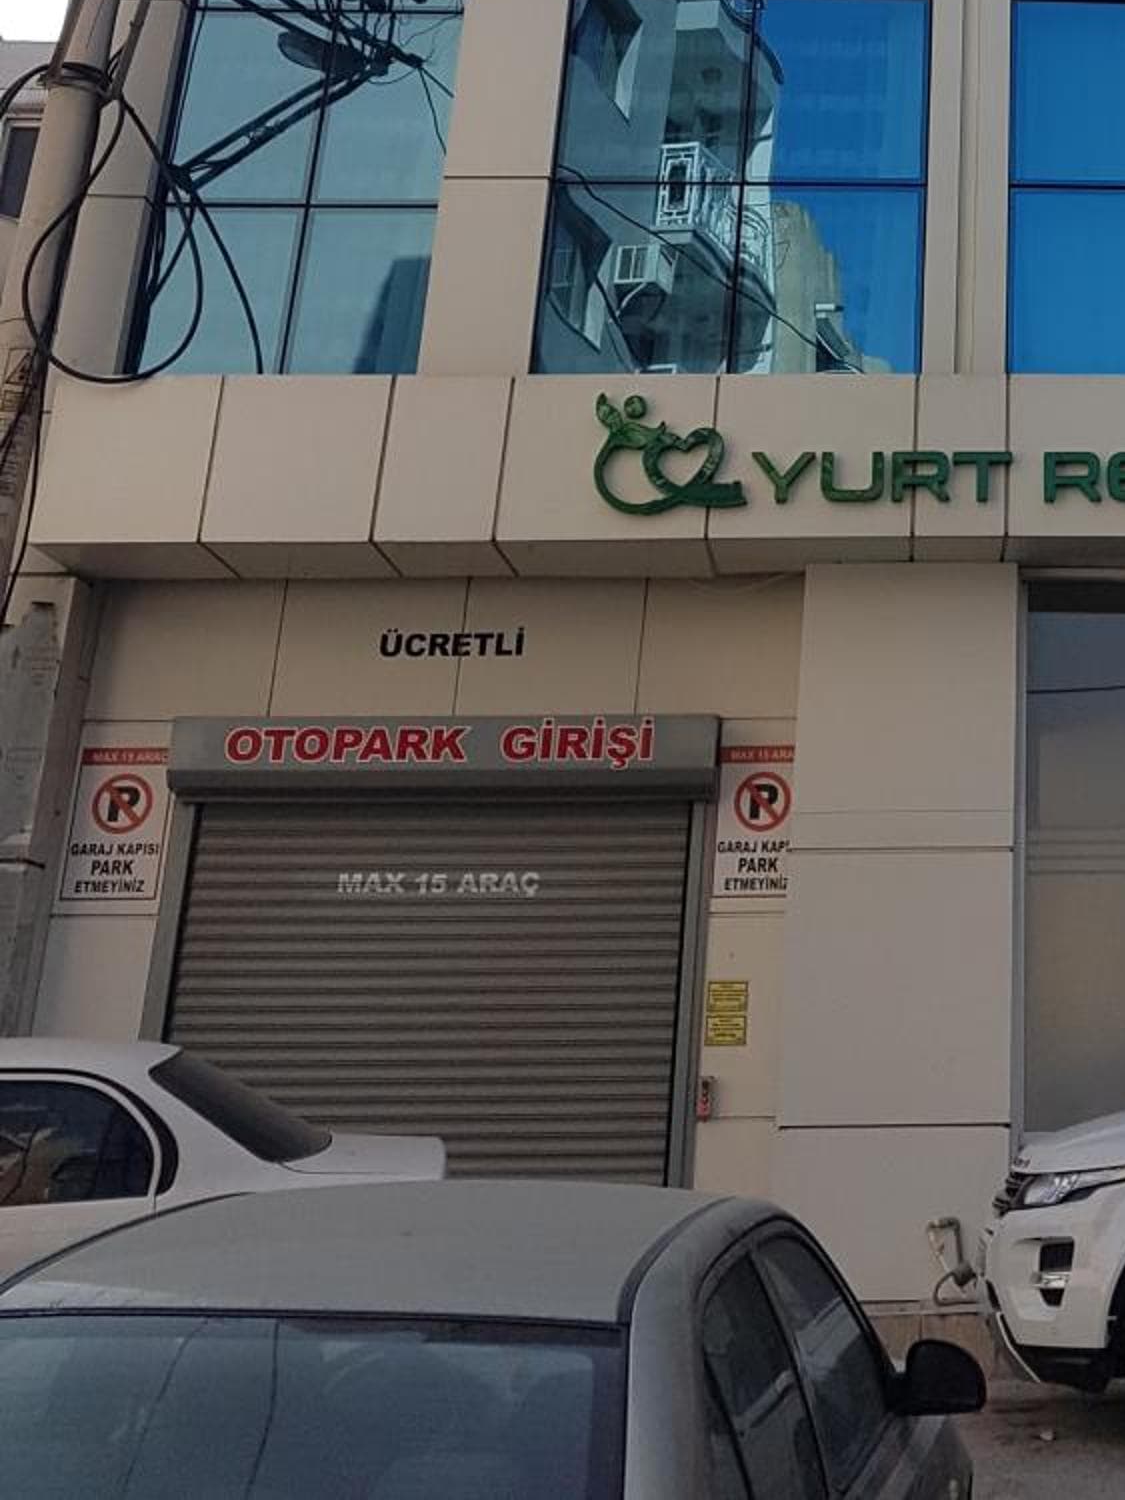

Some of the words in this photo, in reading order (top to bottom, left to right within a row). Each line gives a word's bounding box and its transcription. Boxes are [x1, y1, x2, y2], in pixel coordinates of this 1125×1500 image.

[751, 451, 1013, 506] YURT
[378, 626, 525, 658] ÜCRETLİ
[224, 726, 470, 765] OTOPARK
[500, 717, 655, 769] GİRİŞİ
[71, 842, 113, 857] GARAJ
[116, 842, 160, 857] KAPISI
[717, 839, 758, 853] GARAJ
[90, 859, 136, 876] PARK
[738, 856, 779, 873] PARK
[74, 879, 145, 894] ETMEYİNİZ
[337, 871, 405, 894] MAX
[414, 872, 449, 895] 15
[456, 871, 541, 898] ARAÇ
